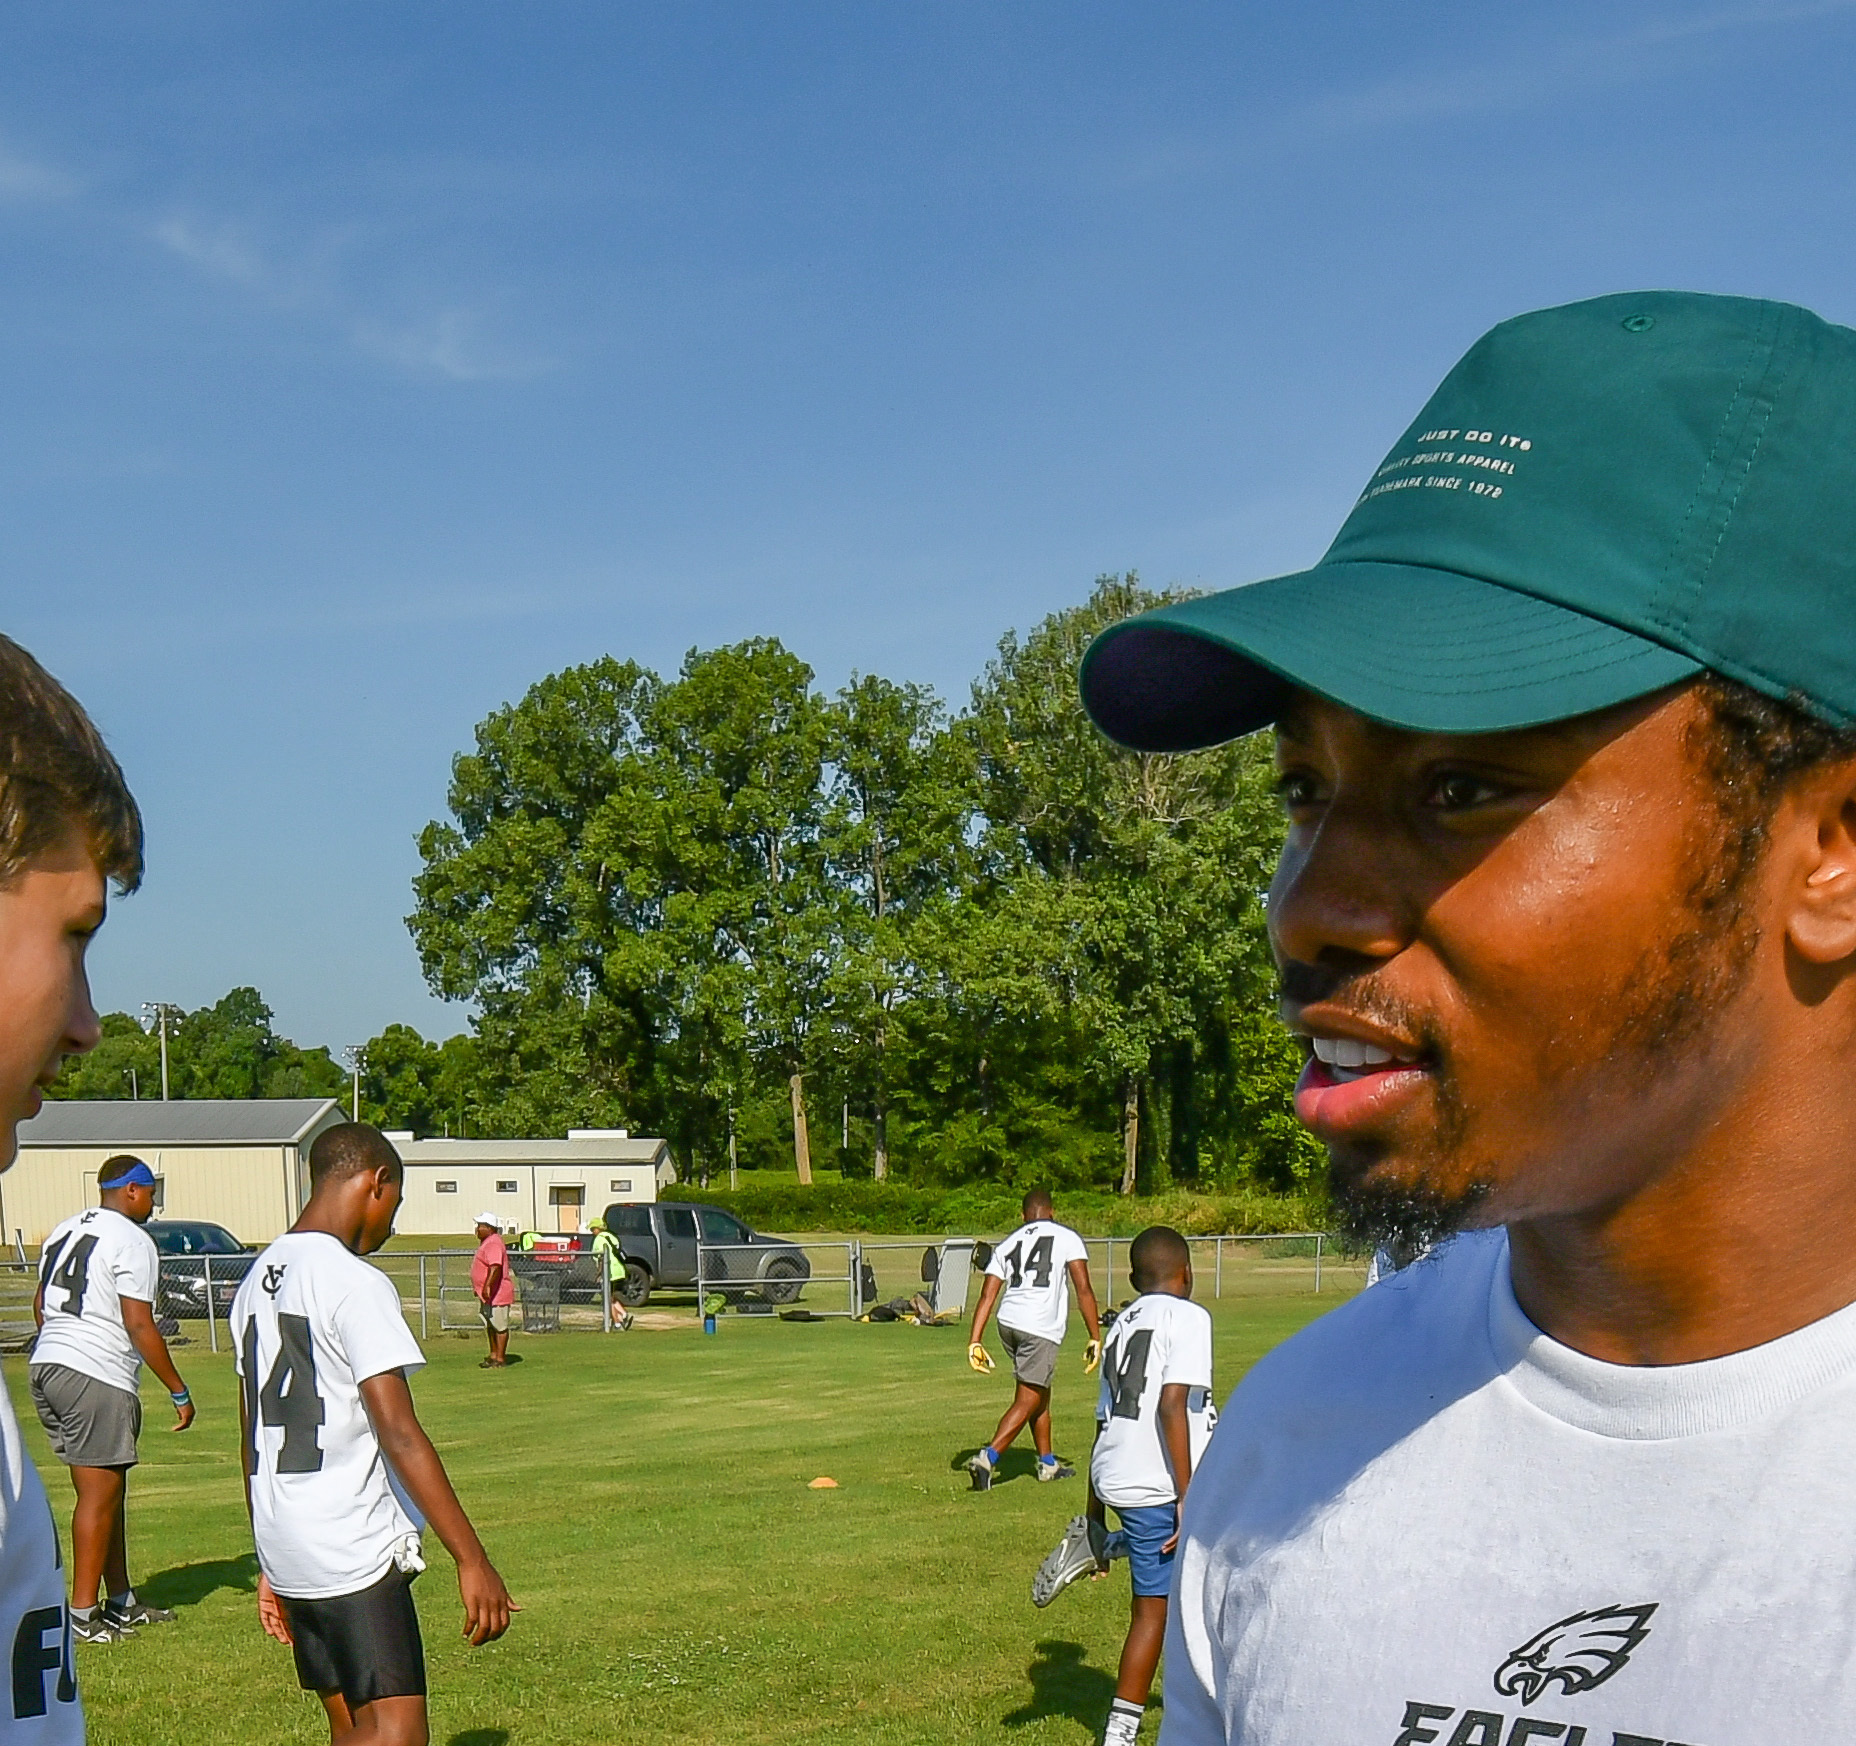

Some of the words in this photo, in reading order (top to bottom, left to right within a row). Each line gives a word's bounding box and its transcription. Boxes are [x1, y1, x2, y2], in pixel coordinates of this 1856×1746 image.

[1417, 429, 1460, 443] JUST
[1464, 430, 1493, 443] DO
[1412, 452, 1455, 466] SPORTS
[1457, 453, 1516, 476] APPAREL
[1425, 475, 1463, 490] SINCE
[1467, 480, 1503, 499] 1972
[44, 1230, 100, 1318] 14
[1005, 1235, 1055, 1288] 14
[242, 1312, 326, 1475] 14
